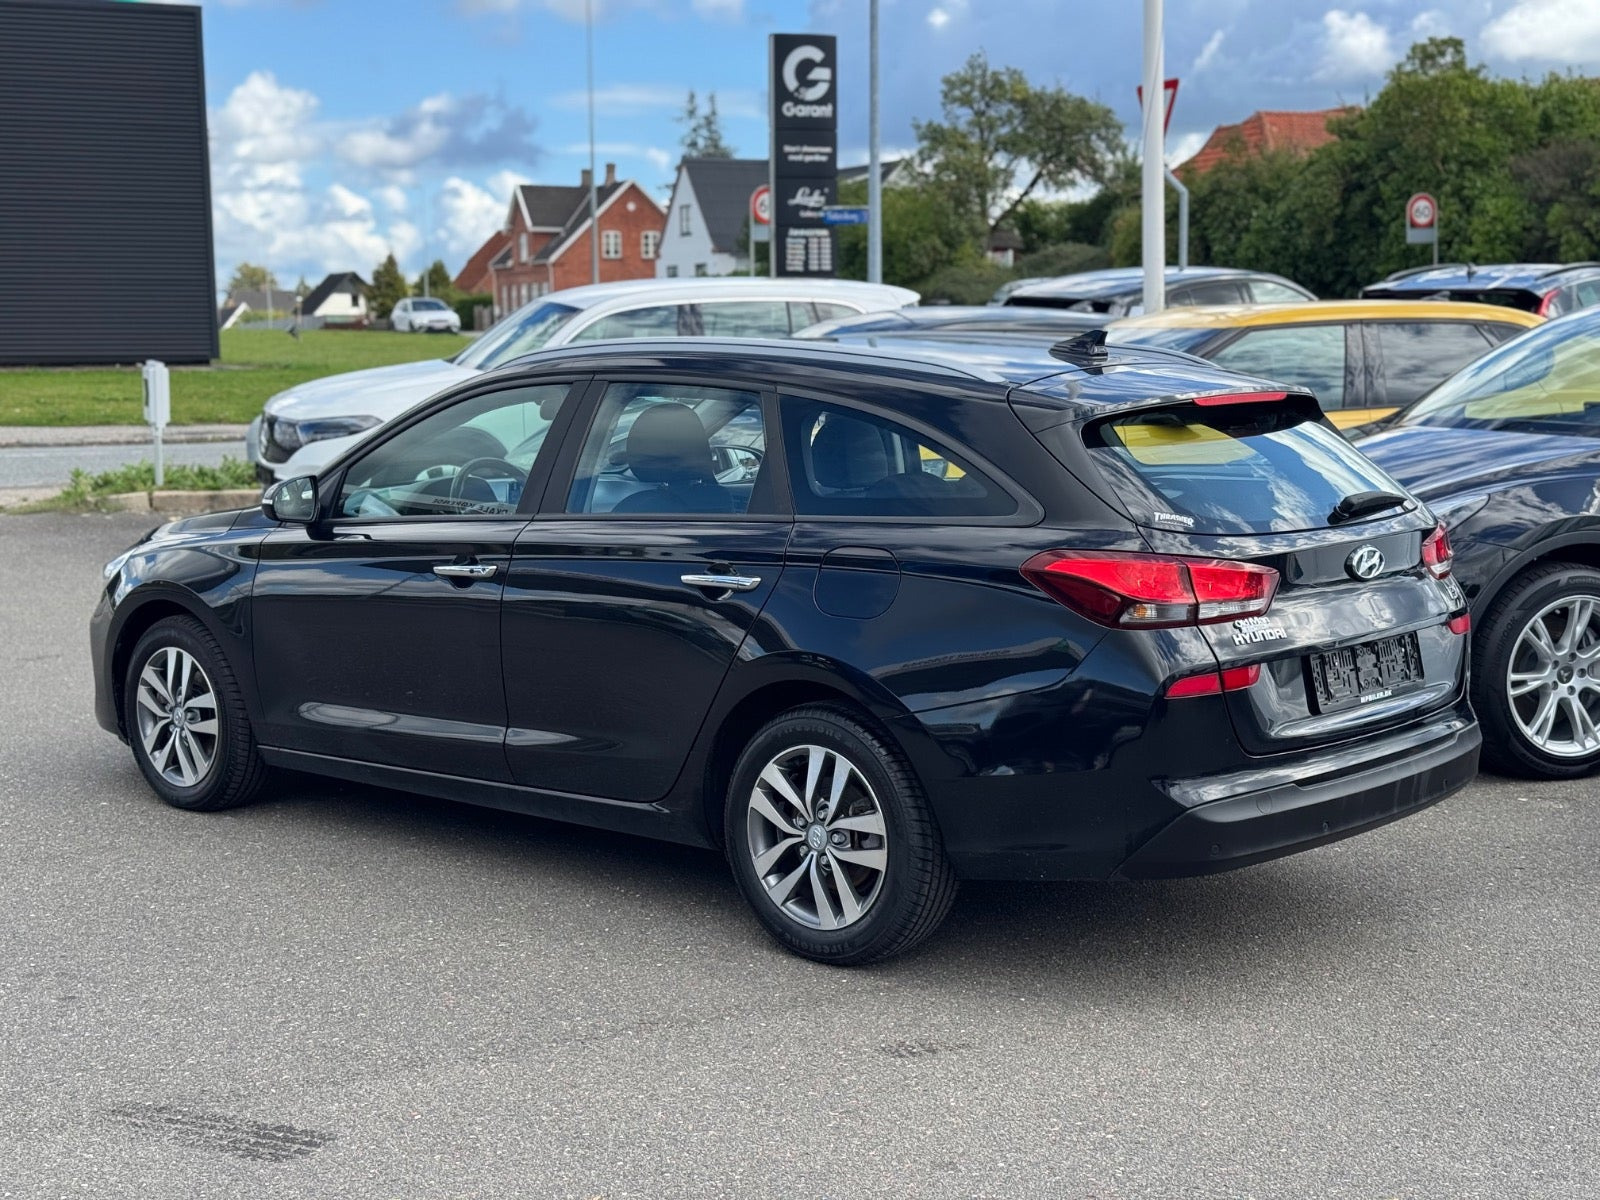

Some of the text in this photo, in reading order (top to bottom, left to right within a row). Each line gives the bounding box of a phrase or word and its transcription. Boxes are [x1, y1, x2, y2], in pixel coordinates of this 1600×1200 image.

[782, 102, 833, 118] Garant
[1415, 205, 1430, 218] 60
[1153, 511, 1195, 528] THRASHER
[1232, 628, 1288, 646] HYUNDAI
